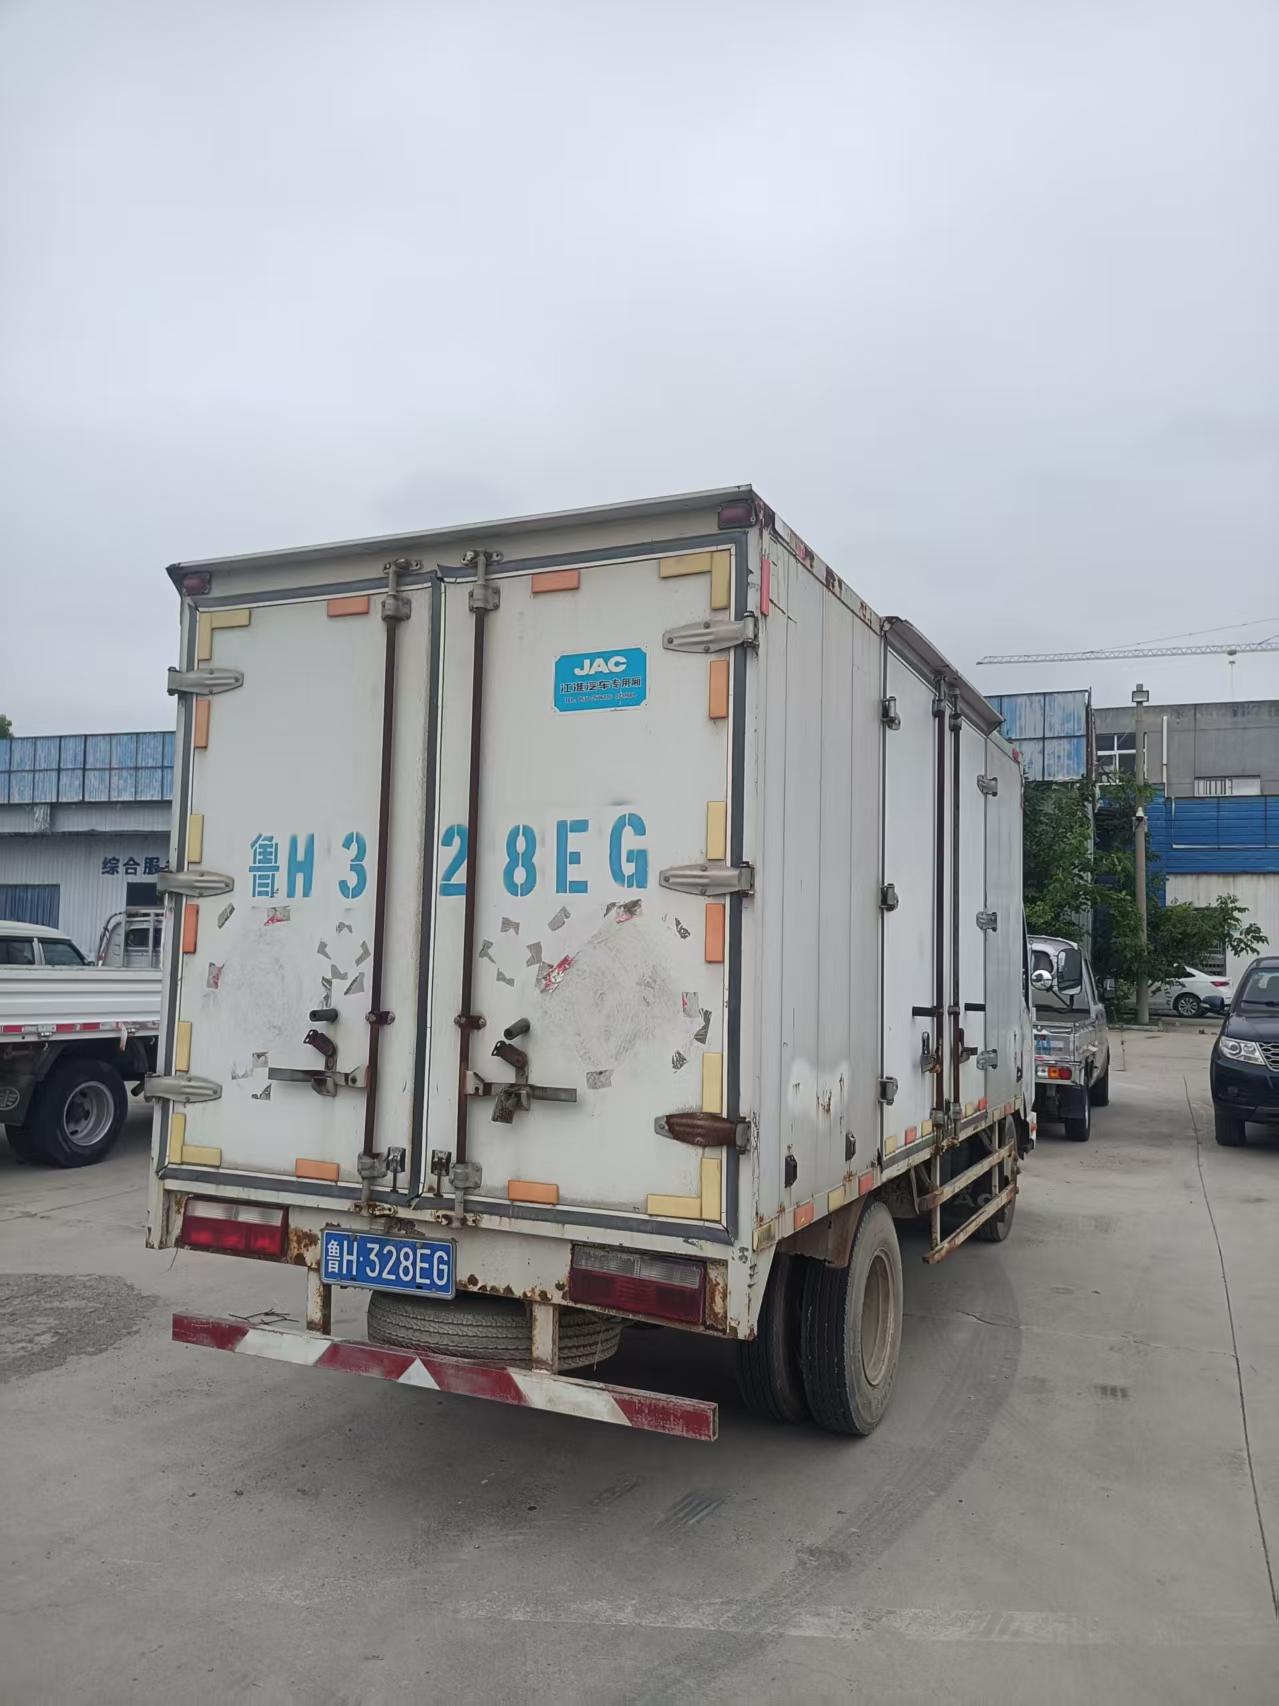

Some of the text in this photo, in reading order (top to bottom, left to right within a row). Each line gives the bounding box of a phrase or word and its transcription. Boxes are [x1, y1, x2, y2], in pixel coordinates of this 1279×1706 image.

[574, 655, 627, 676] JAC
[101, 856, 170, 876] 综合服
